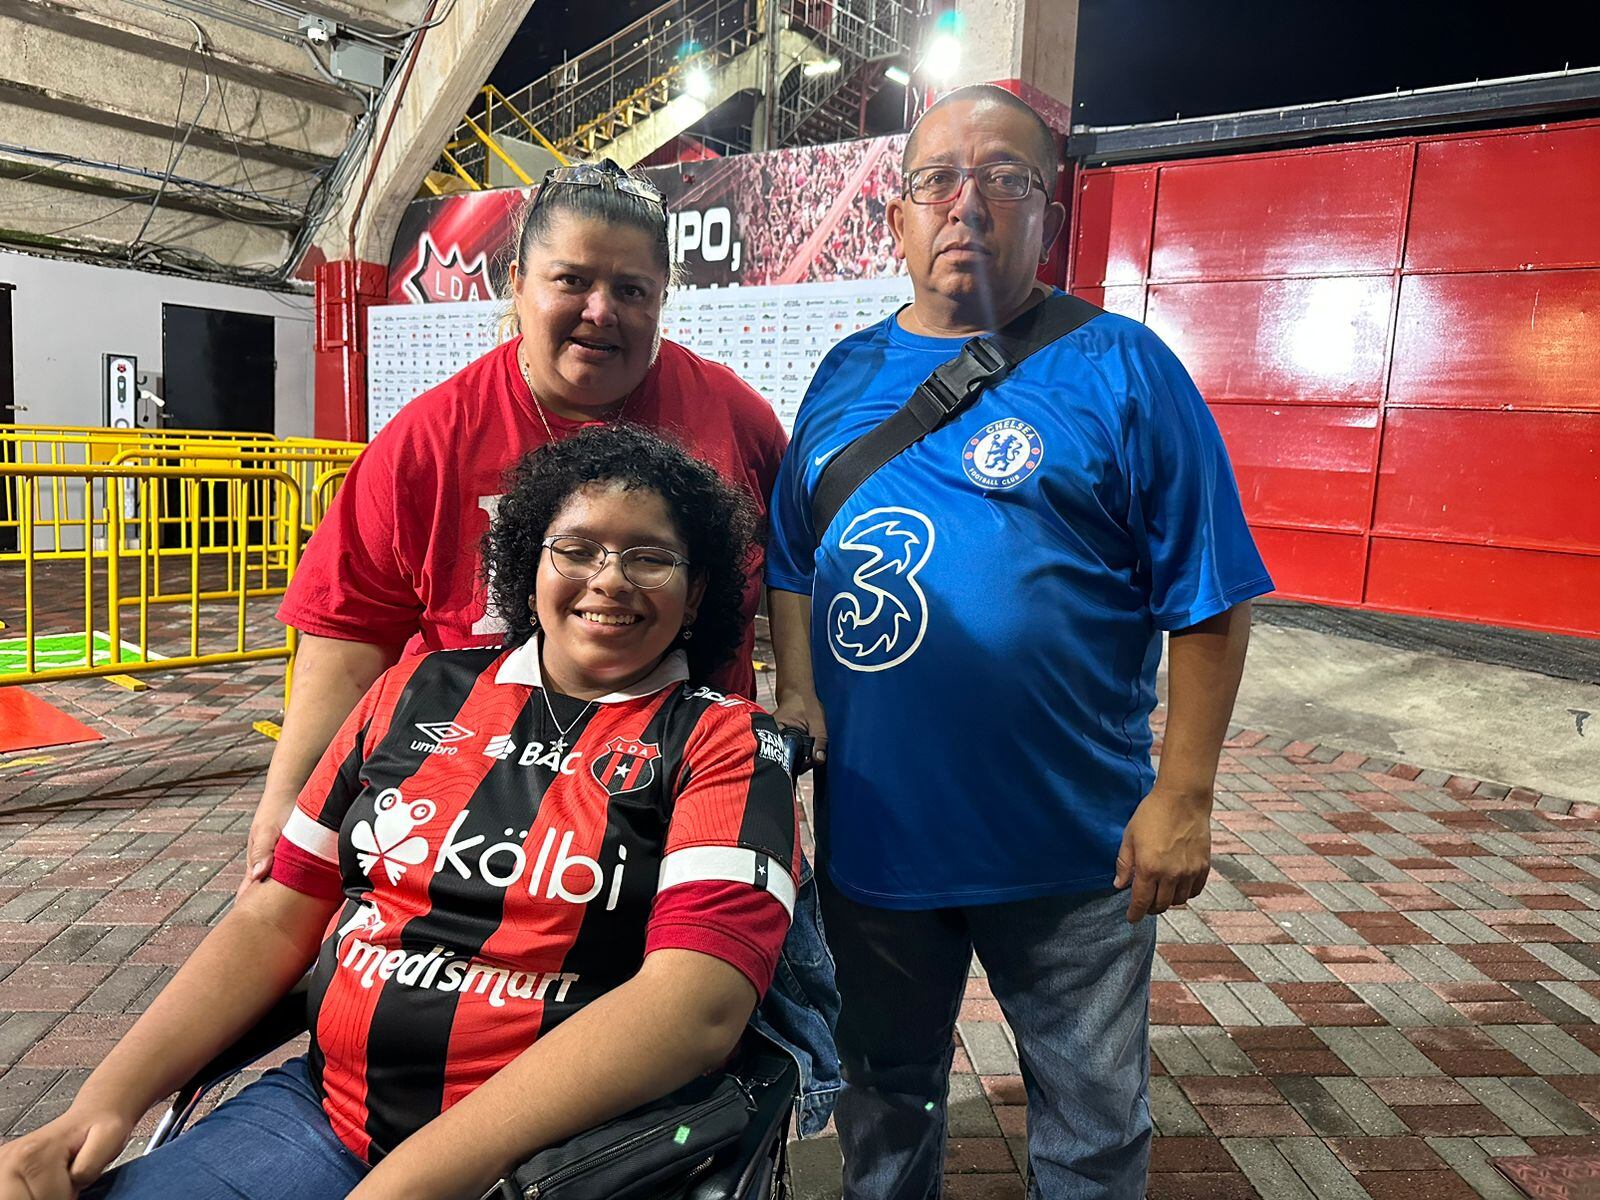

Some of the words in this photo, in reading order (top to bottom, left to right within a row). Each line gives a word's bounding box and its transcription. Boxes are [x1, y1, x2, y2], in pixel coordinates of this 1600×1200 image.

[435, 270, 480, 302] LDA
[985, 419, 1036, 441] CHELSEA
[968, 467, 999, 487] FOOTBALL
[1001, 473, 1021, 486] CLUB
[410, 739, 459, 756] umbro
[615, 743, 648, 757] LDA
[757, 732, 786, 752] SAN
[518, 741, 583, 776] BAC
[433, 809, 628, 911] kölbi
[342, 938, 580, 1008] medismart
